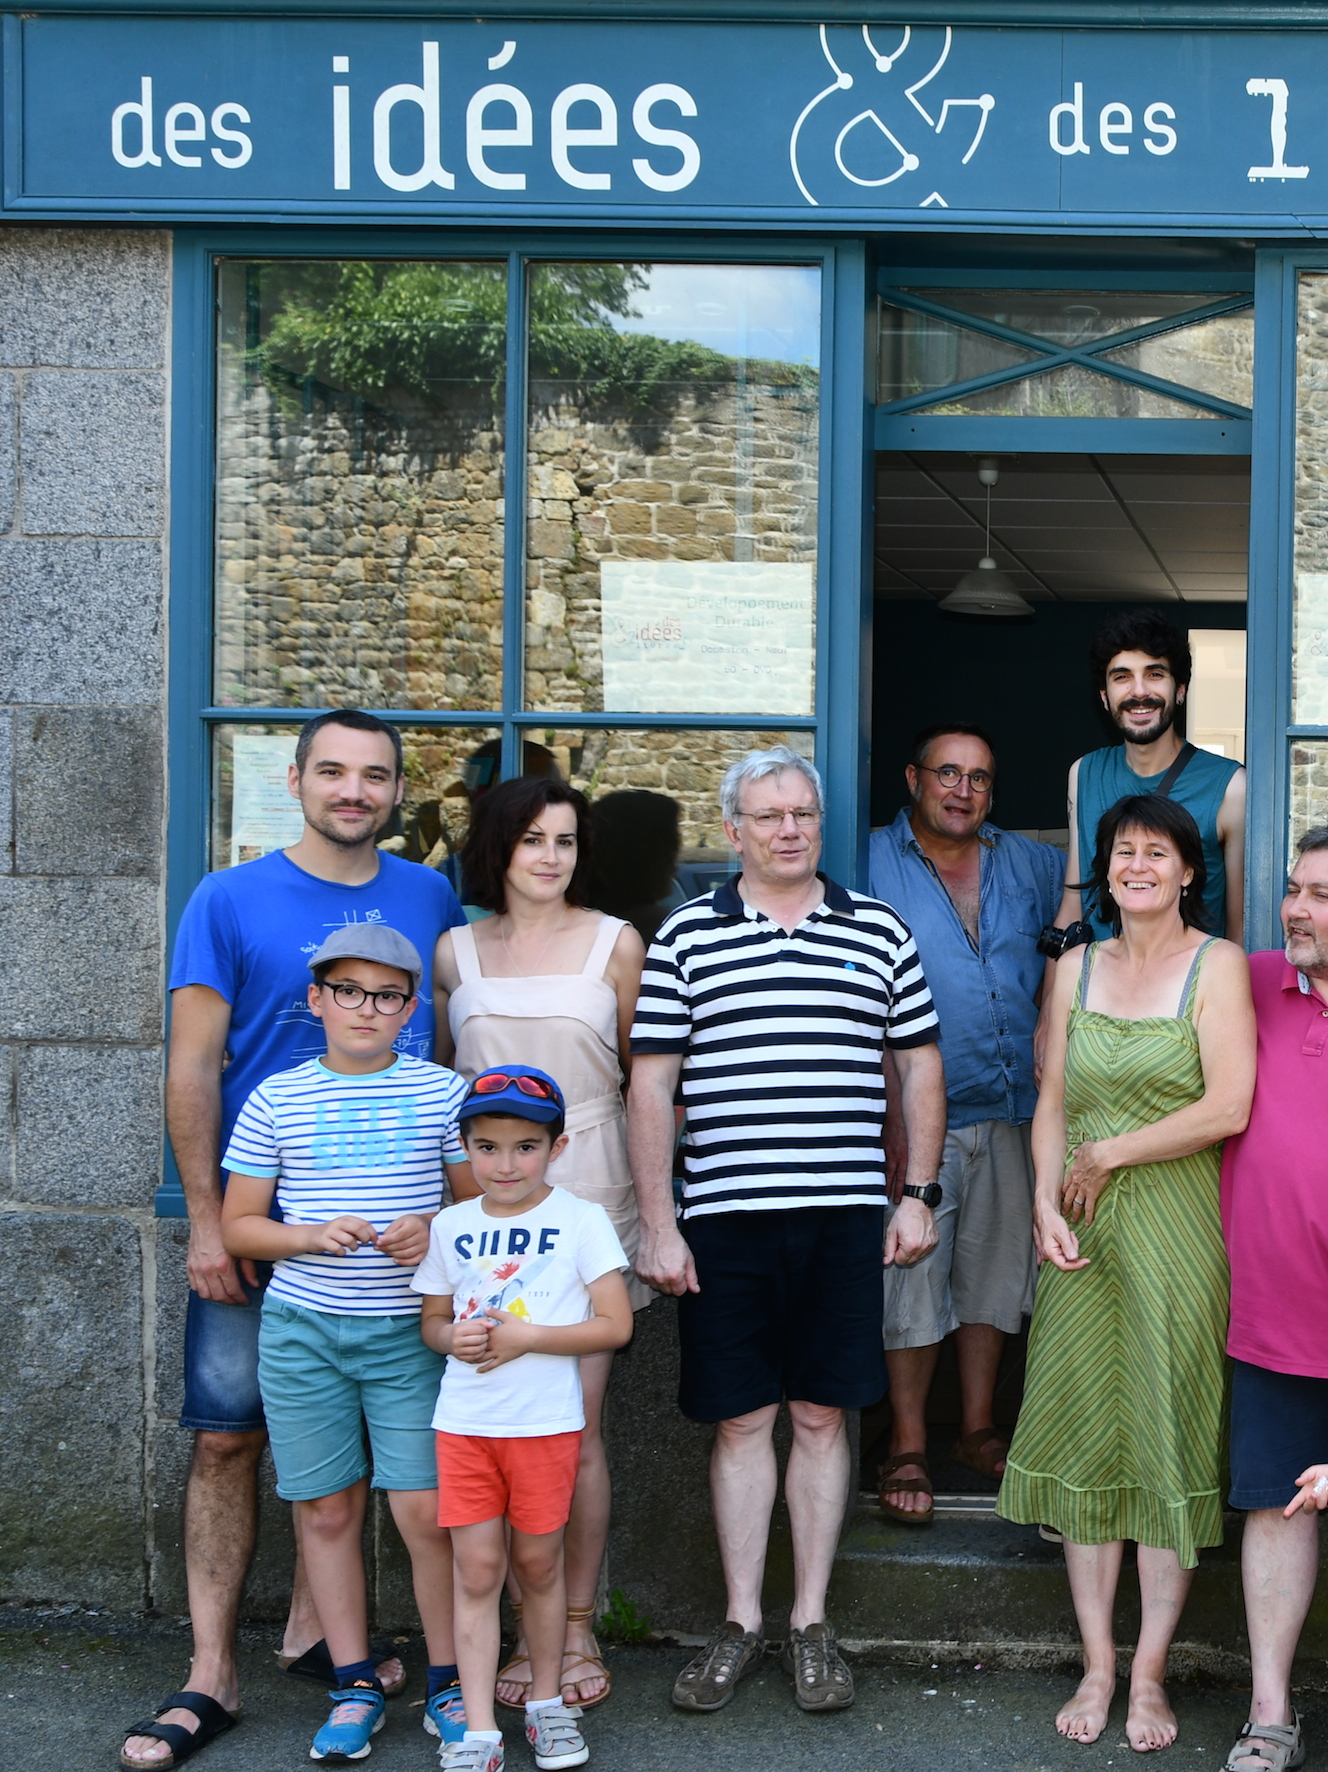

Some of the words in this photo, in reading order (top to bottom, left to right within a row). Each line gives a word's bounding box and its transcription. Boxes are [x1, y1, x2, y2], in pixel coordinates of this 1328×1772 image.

[111, 76, 253, 169] des
[333, 41, 701, 192] idées
[1049, 82, 1177, 156] des
[635, 622, 682, 641] idées
[309, 1130, 420, 1172] SURF
[454, 1227, 560, 1261] SURF
